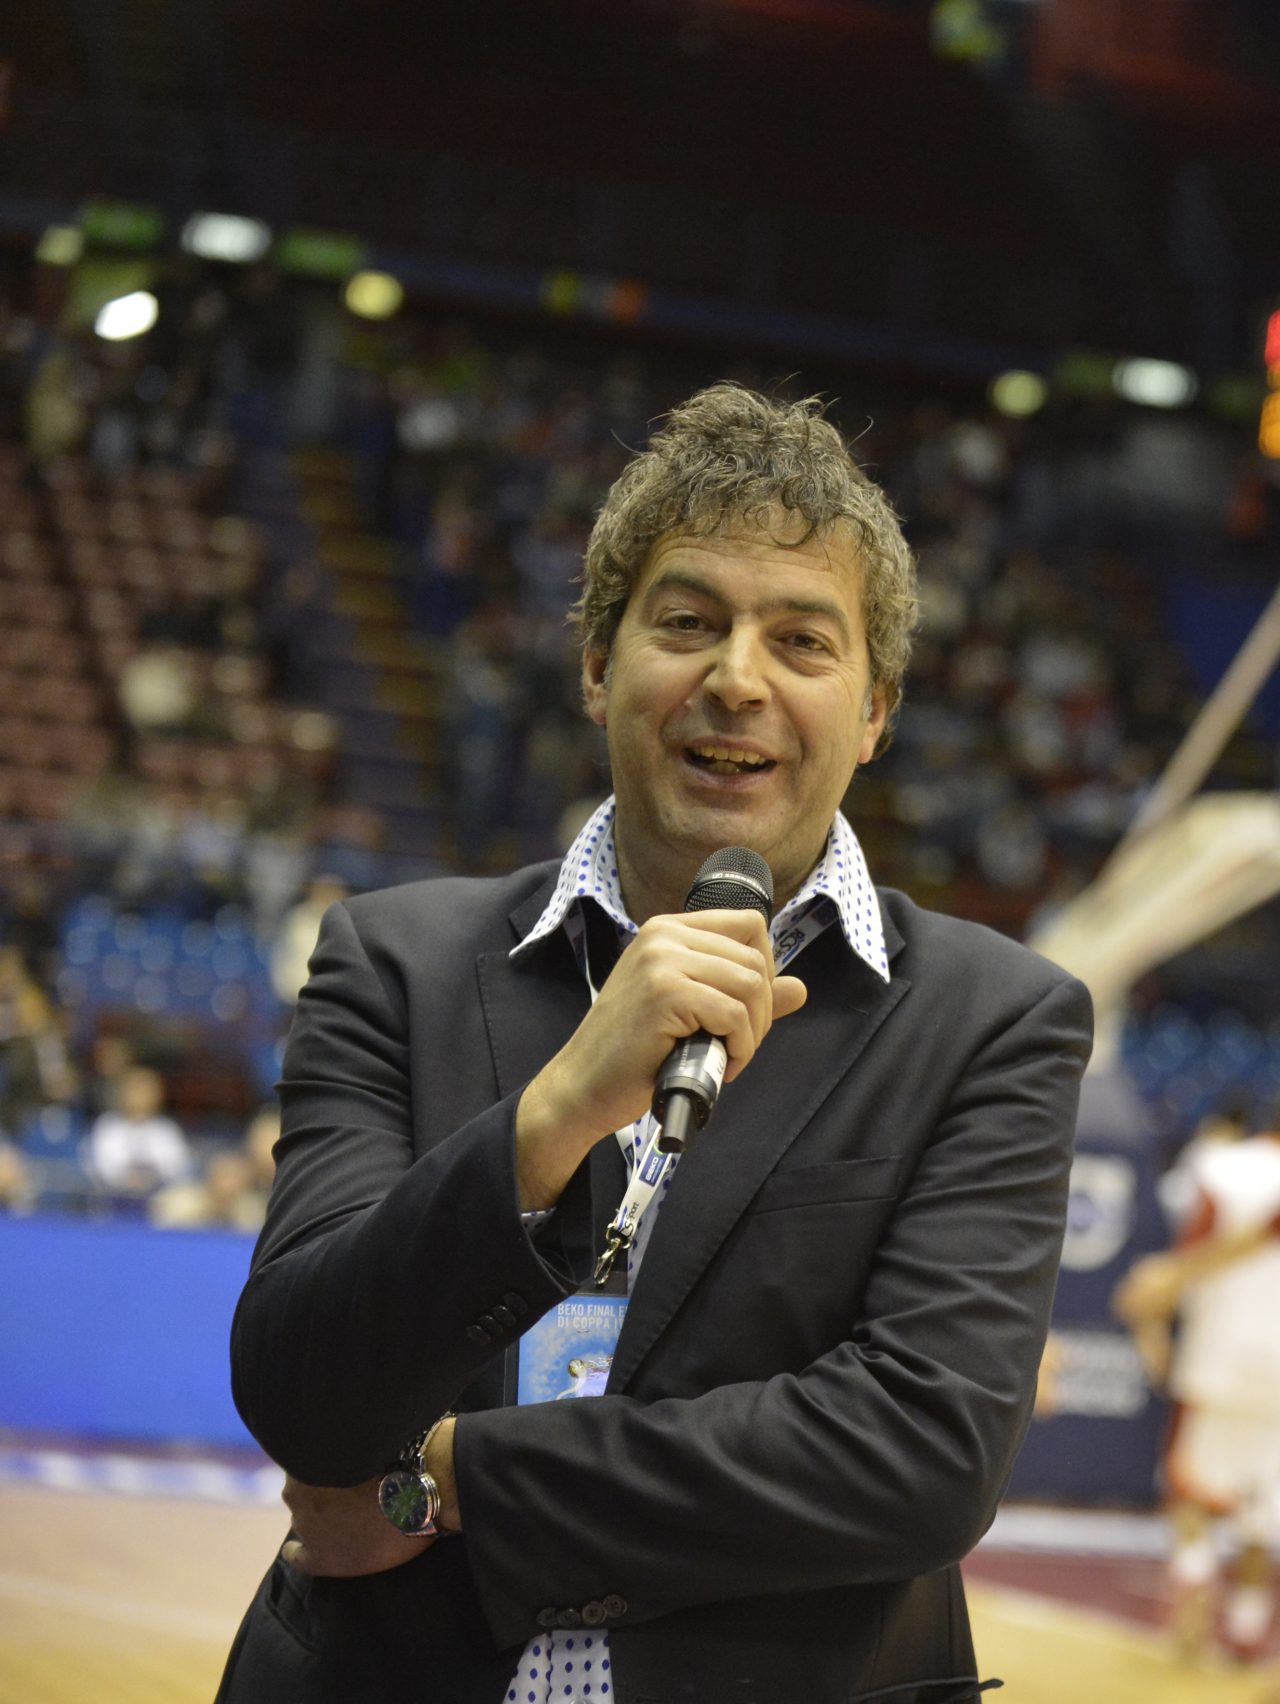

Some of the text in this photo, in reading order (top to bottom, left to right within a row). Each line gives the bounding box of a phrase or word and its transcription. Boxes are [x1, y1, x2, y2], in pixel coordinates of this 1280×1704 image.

[557, 1303, 584, 1316] BEKO
[587, 1304, 615, 1317] FINAL
[557, 1316, 569, 1328] DI
[573, 1316, 610, 1329] COPPA
